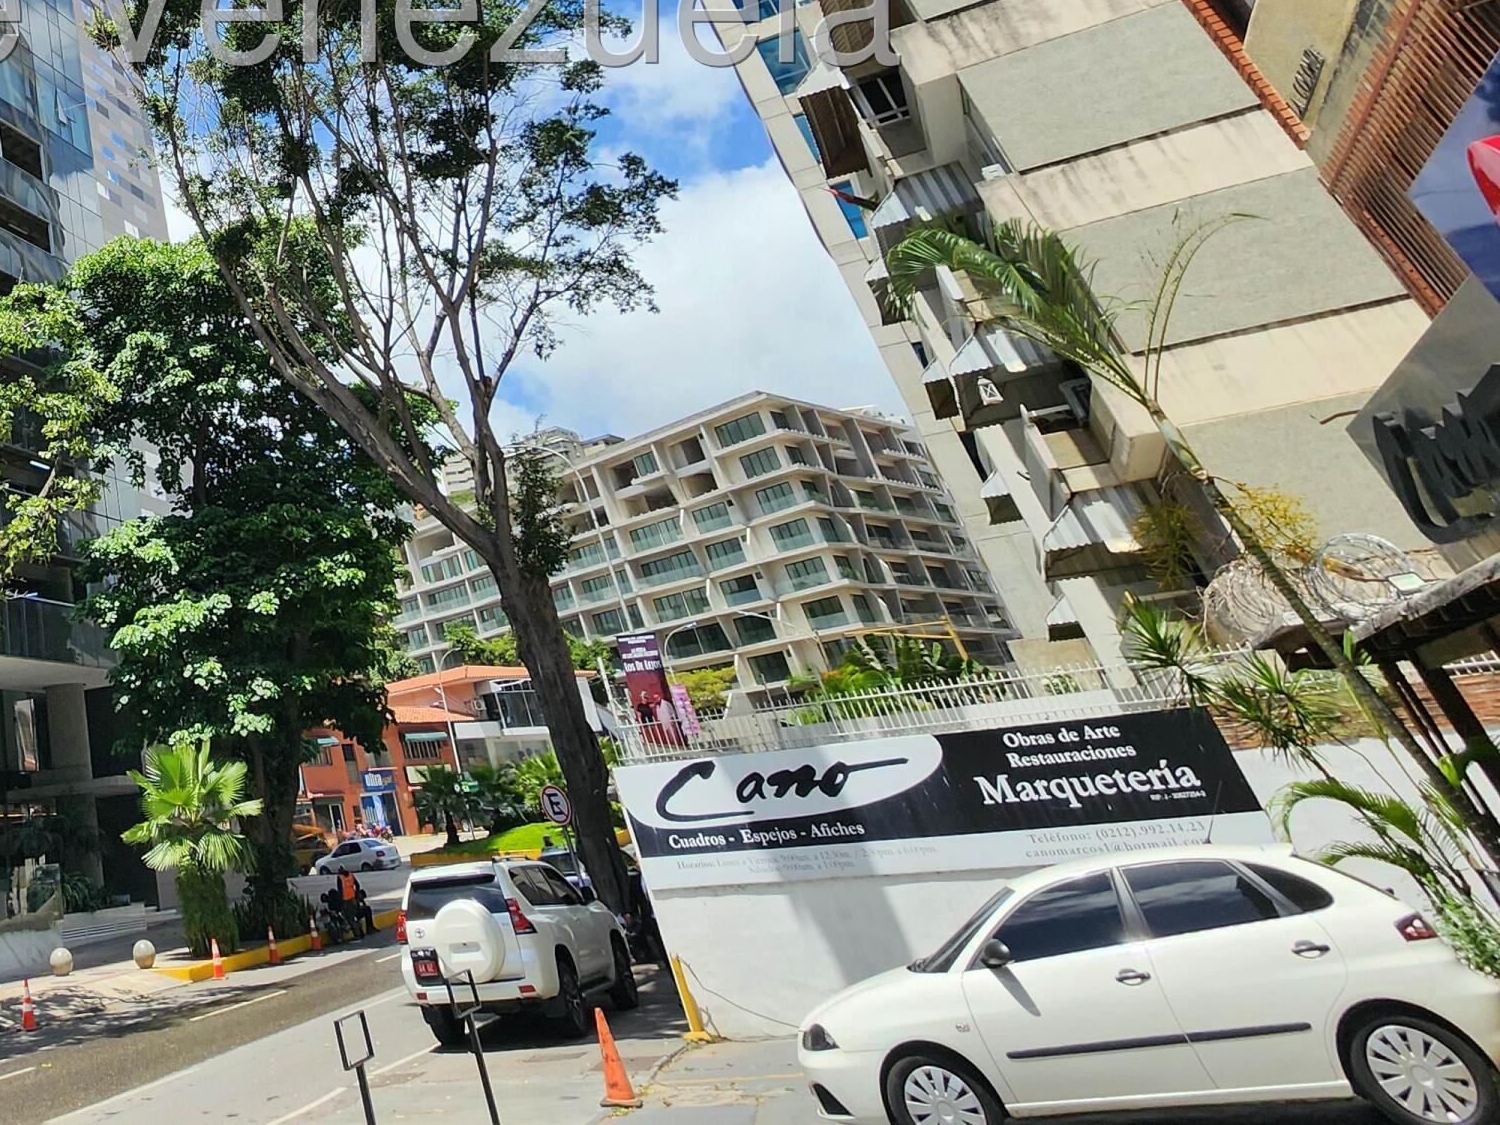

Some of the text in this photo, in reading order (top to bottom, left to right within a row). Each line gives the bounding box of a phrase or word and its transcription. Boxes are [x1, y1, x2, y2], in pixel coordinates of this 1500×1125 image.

[1002, 725, 1121, 748] Obras de Arte
[1006, 743, 1137, 768] Restauraciones
[656, 759, 909, 823] Cano
[973, 759, 1202, 808] Marquetería
[668, 832, 726, 849] Cuadros
[741, 825, 797, 847] Espejos
[810, 822, 866, 839] Afiches
